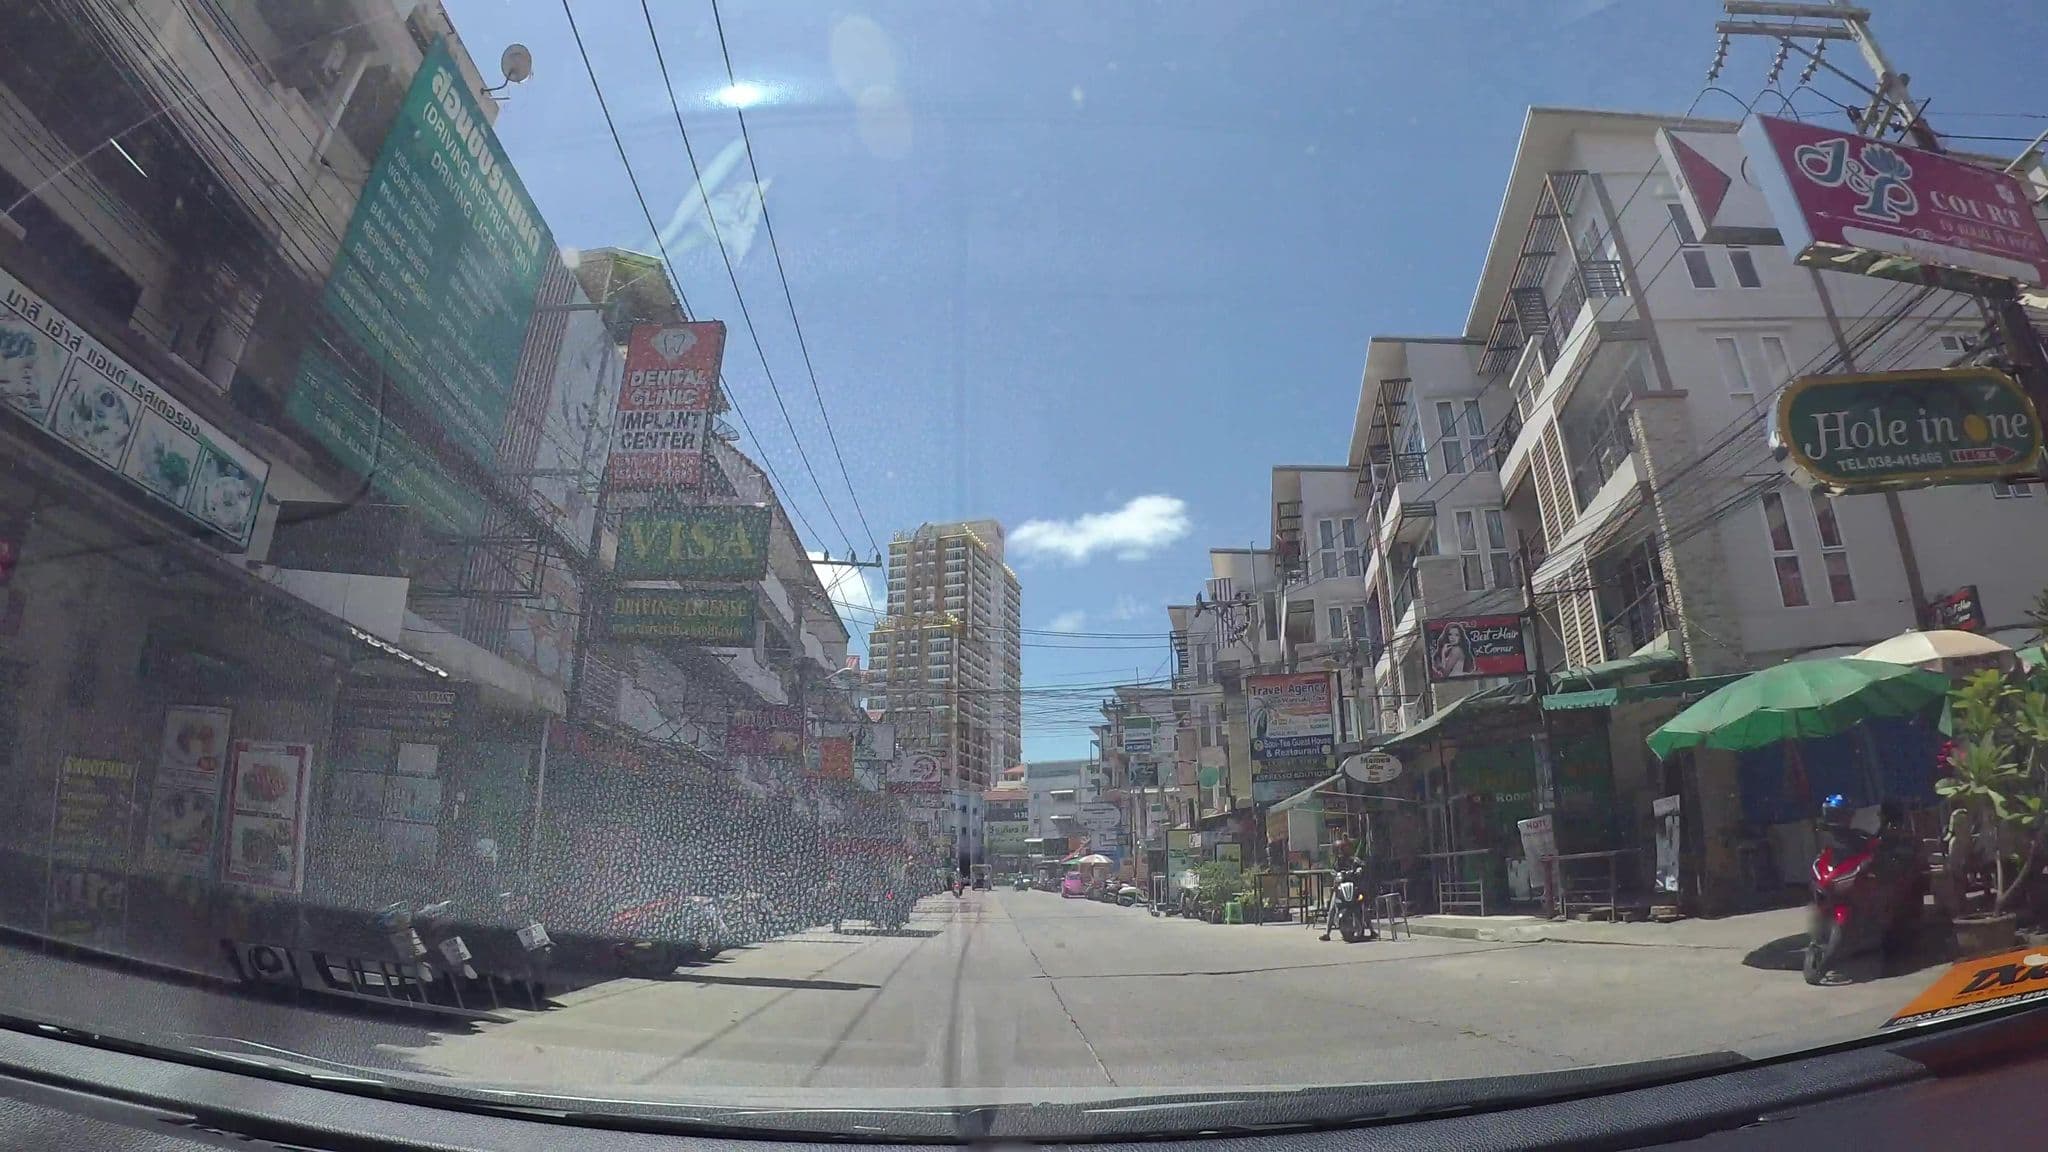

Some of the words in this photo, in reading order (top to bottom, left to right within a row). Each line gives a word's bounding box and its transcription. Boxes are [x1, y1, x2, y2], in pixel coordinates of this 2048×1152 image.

[423, 101, 470, 179] (DRIVING
[387, 161, 411, 199] WORK
[393, 147, 411, 175] VISA
[430, 150, 473, 217] DRIVING
[370, 200, 407, 252] BALANCE
[1930, 190, 2021, 228] COURT
[353, 242, 376, 275] REAL
[362, 219, 401, 270] RESIDENT
[630, 368, 707, 387] DENTAL
[620, 411, 702, 430] IMPLANT
[1804, 407, 1909, 461] Hole
[1917, 407, 1959, 443] in
[622, 431, 697, 450] CENTER
[630, 520, 752, 562] VISA
[1251, 685, 1283, 697] Travel
[1288, 683, 1327, 698] Agency
[1274, 747, 1320, 757] Restaurant
